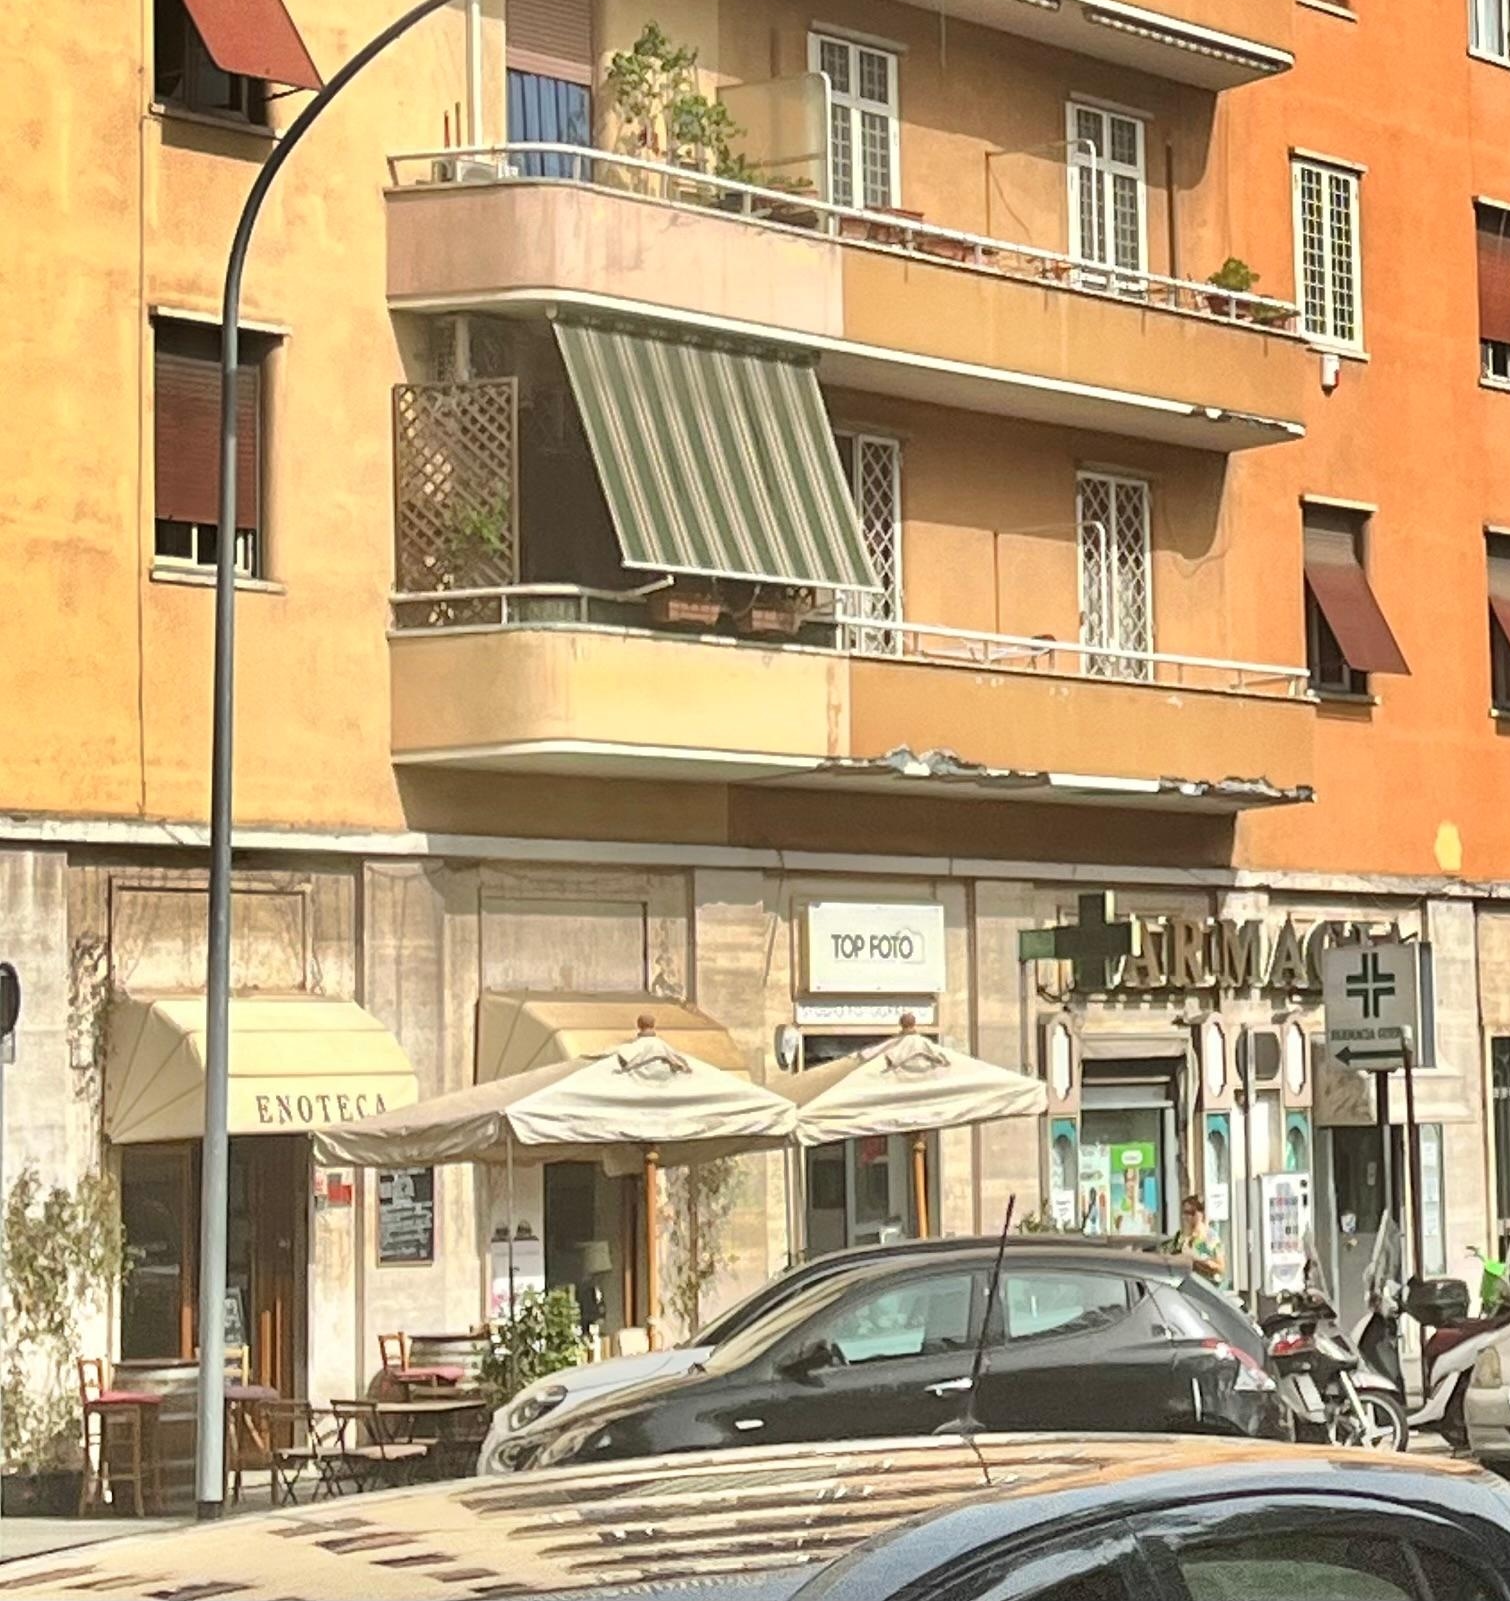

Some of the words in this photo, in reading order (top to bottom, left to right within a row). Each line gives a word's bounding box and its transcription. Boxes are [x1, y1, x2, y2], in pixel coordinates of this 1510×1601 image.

[831, 934, 865, 959] TOP
[870, 934, 914, 959] FOTO
[255, 1092, 387, 1124] ENOTECA
